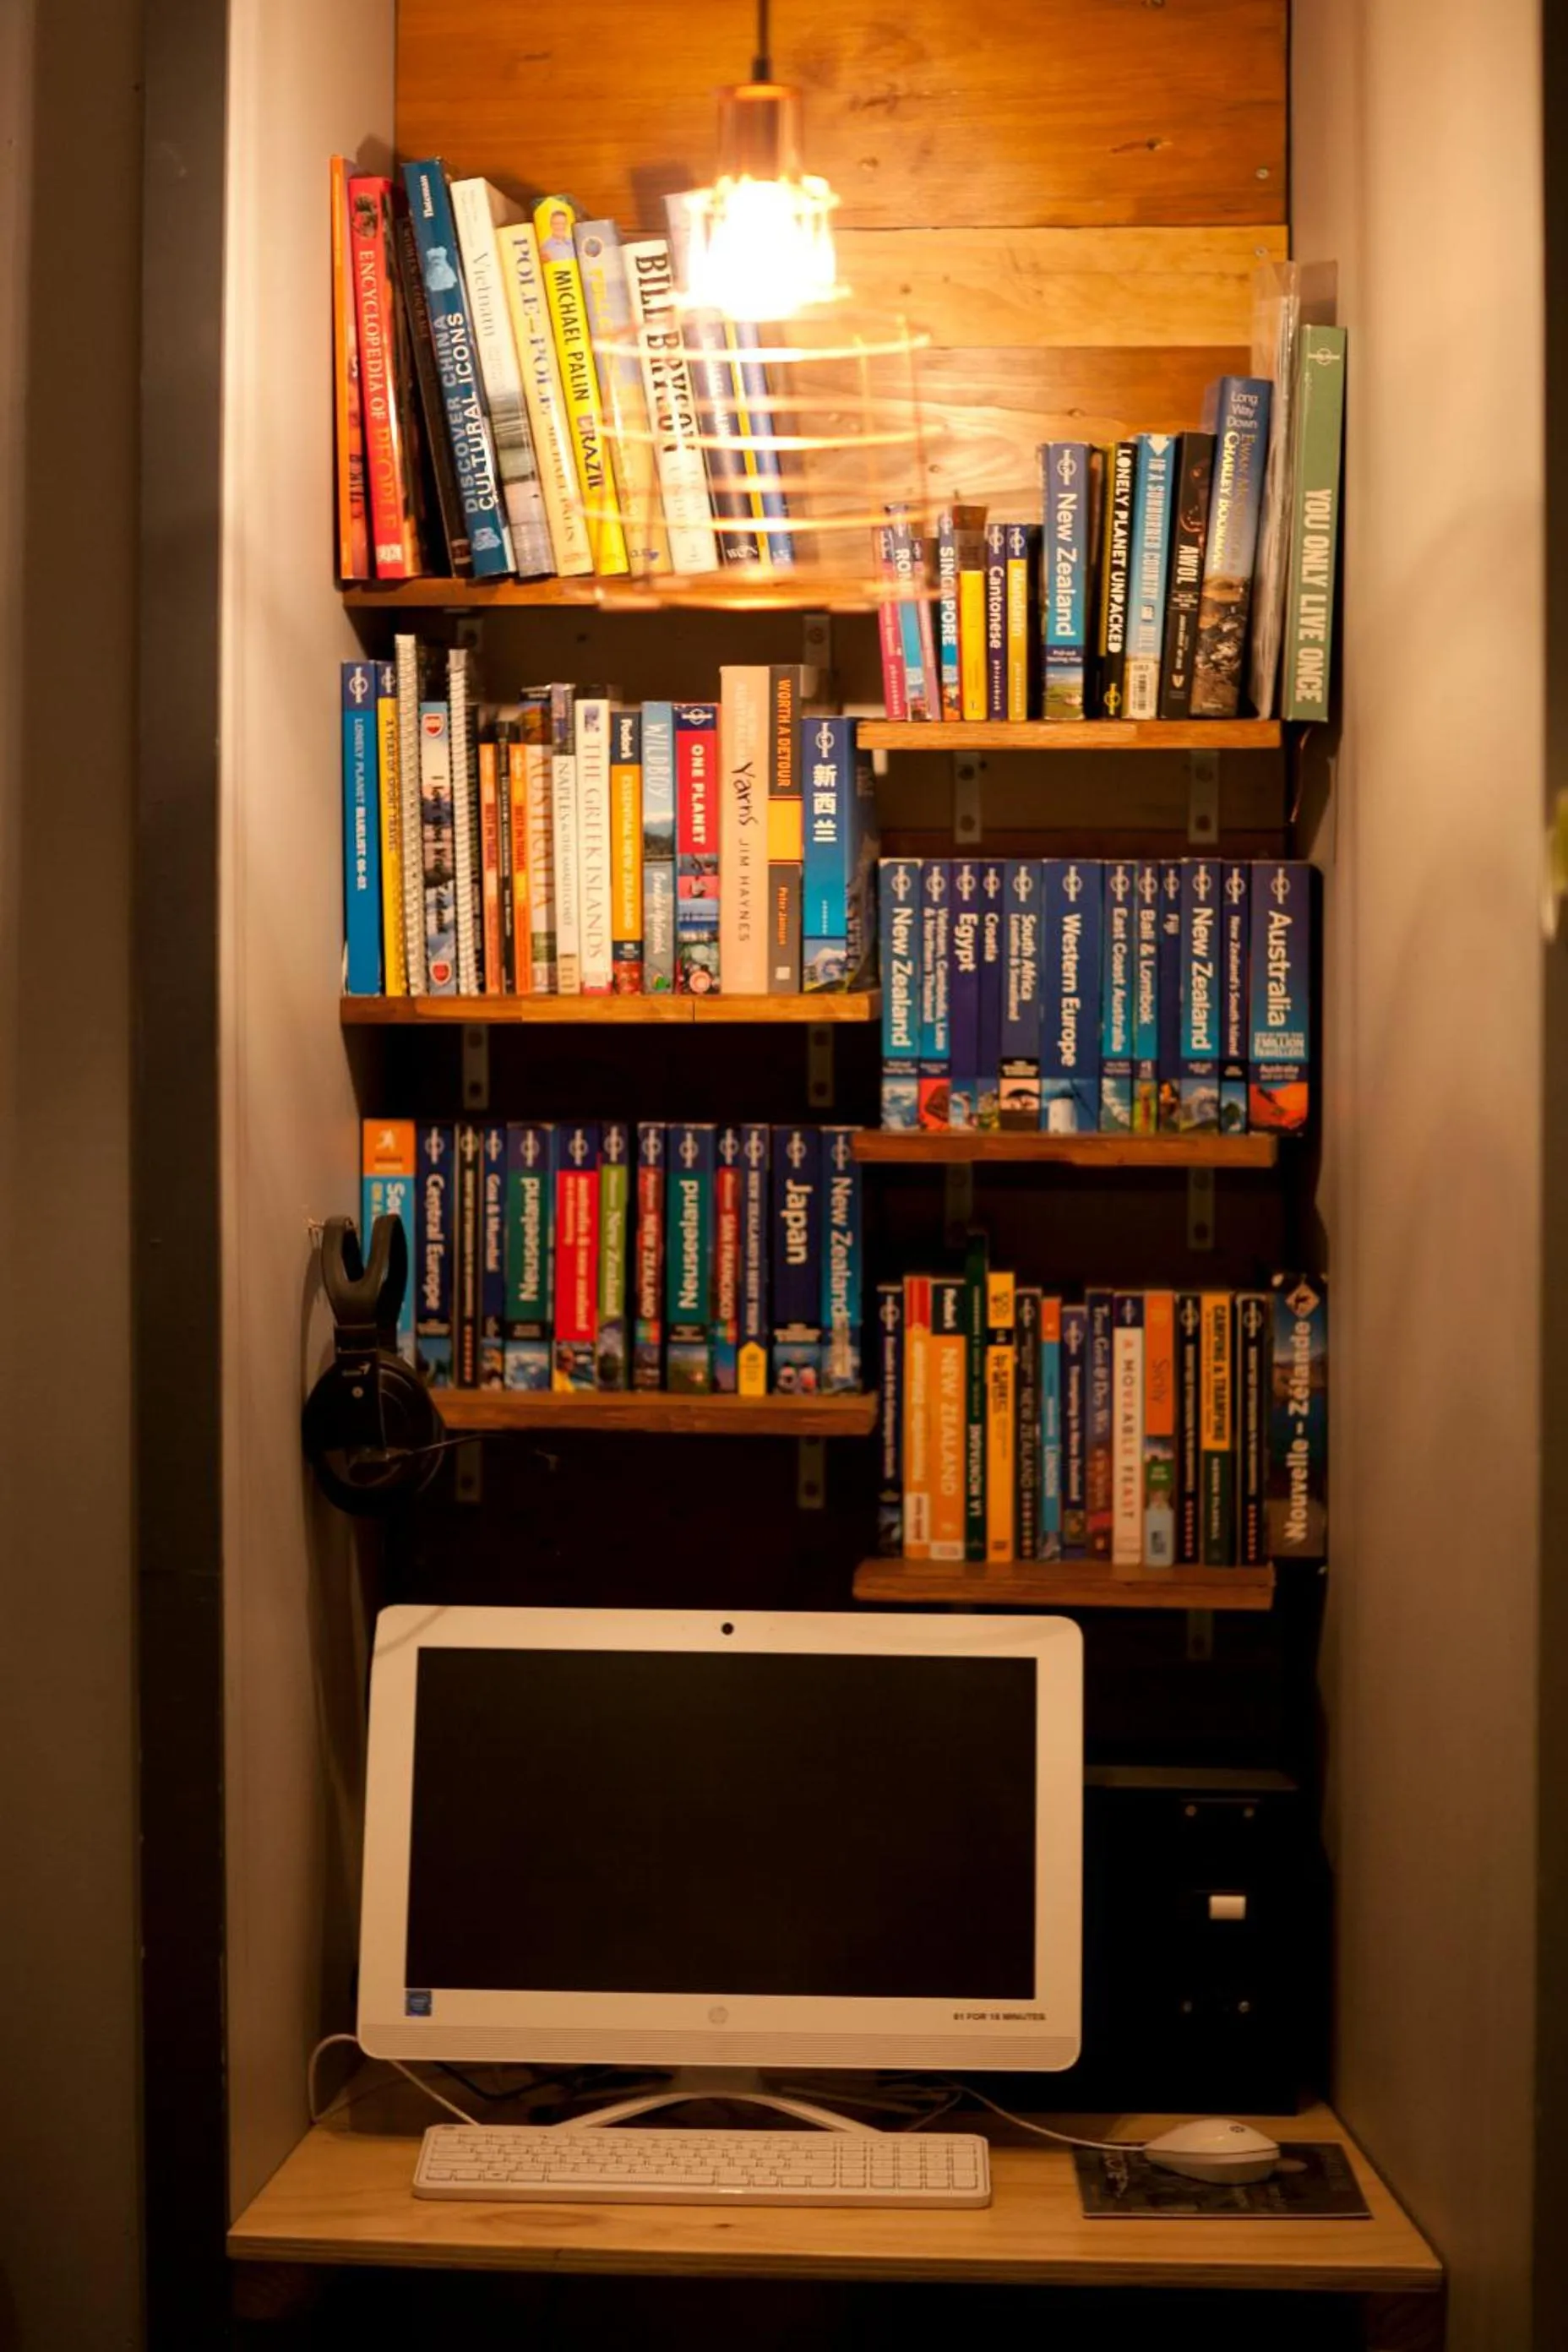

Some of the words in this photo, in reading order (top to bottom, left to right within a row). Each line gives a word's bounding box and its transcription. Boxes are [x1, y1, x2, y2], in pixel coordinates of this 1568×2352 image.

[472, 252, 495, 338] Vietnam
[512, 237, 541, 318] POLE
[553, 270, 581, 346] MICHAEL
[636, 254, 673, 319] BILL
[359, 250, 386, 395] ENCYCLOPEDIA
[432, 315, 458, 388] CHINA
[447, 313, 475, 386] ICONS
[567, 351, 590, 401] PALIN
[647, 333, 694, 452] BRYSON
[1231, 391, 1259, 406] Long
[371, 396, 386, 421] OF
[1227, 413, 1259, 429] Down
[1233, 402, 1255, 417] Way
[373, 424, 397, 529] PEOPLE
[451, 403, 478, 514] DISCOVER
[463, 391, 496, 511] CULTURAL
[576, 415, 604, 491] BRAZIL
[1113, 449, 1132, 505] LONELY
[1220, 432, 1239, 497] CHARLEY
[1058, 493, 1077, 542] New
[1111, 509, 1130, 567] PLANET
[1304, 489, 1332, 530] YOU
[1056, 547, 1077, 636] Zealand
[1141, 552, 1161, 600] COUNTRY
[1176, 545, 1199, 584] AWOL
[1302, 535, 1330, 587] ONLY
[939, 547, 956, 646] SINGAPORE
[989, 566, 1004, 649] Cantonese
[1010, 568, 1024, 637] Mandarin
[1107, 572, 1126, 653] UNPACKED
[1299, 595, 1327, 640] LIVE
[777, 678, 792, 724] WORTH
[1296, 648, 1325, 704] ONCE
[354, 718, 365, 759] LONELY
[645, 722, 669, 798] WILDBOY
[691, 744, 705, 777] ONE
[777, 727, 791, 736] A
[777, 738, 792, 787] DETOUR
[355, 761, 366, 803] PLANET
[558, 762, 574, 820] NAPLES
[585, 743, 602, 785] THE
[731, 761, 759, 827] Yarns
[531, 753, 553, 911] AUSTRALIA
[584, 788, 603, 860] GREEK
[622, 776, 632, 836] ESSENTIAL
[692, 782, 705, 845] PLANET
[813, 764, 837, 843] 新西兰
[623, 840, 633, 869] NEW
[738, 839, 750, 867] JIM
[585, 866, 605, 959] ISLANDS
[623, 872, 634, 929] ZEALAND
[738, 876, 751, 942] HAYNES
[777, 886, 790, 909] Peter
[1113, 907, 1127, 939] East
[1140, 909, 1157, 939] Bali
[892, 906, 913, 956] New
[954, 913, 978, 972] Egypt
[984, 912, 999, 962] Croatia
[1021, 913, 1037, 956] South
[1061, 913, 1081, 993] Western
[1140, 944, 1156, 956] &
[1191, 906, 1213, 956] New
[1021, 960, 1036, 1001] Africa
[1112, 943, 1127, 985] Coast
[1139, 960, 1155, 1025] Lombok
[1268, 910, 1293, 1026] Australia
[891, 960, 913, 1048] Zealand
[1057, 997, 1081, 1067] Europe
[1112, 988, 1127, 1052] Australia
[1191, 961, 1213, 1050] Zealand
[425, 1173, 444, 1240] Central
[781, 1179, 813, 1265] Japan
[831, 1177, 852, 1225] New
[519, 1177, 540, 1301] Neuseeland
[678, 1180, 699, 1309] Neuseeland
[423, 1244, 444, 1310] Europe
[830, 1230, 852, 1319] Zealand
[940, 1348, 958, 1398] NEW
[1288, 1321, 1311, 1417] Zélande
[1122, 1358, 1135, 1456] MOVEABLE
[940, 1402, 958, 1496] ZEALAND
[969, 1500, 980, 1516] LA
[1121, 1465, 1135, 1520] FEAST
[1284, 1438, 1309, 1544] Nouvelle
